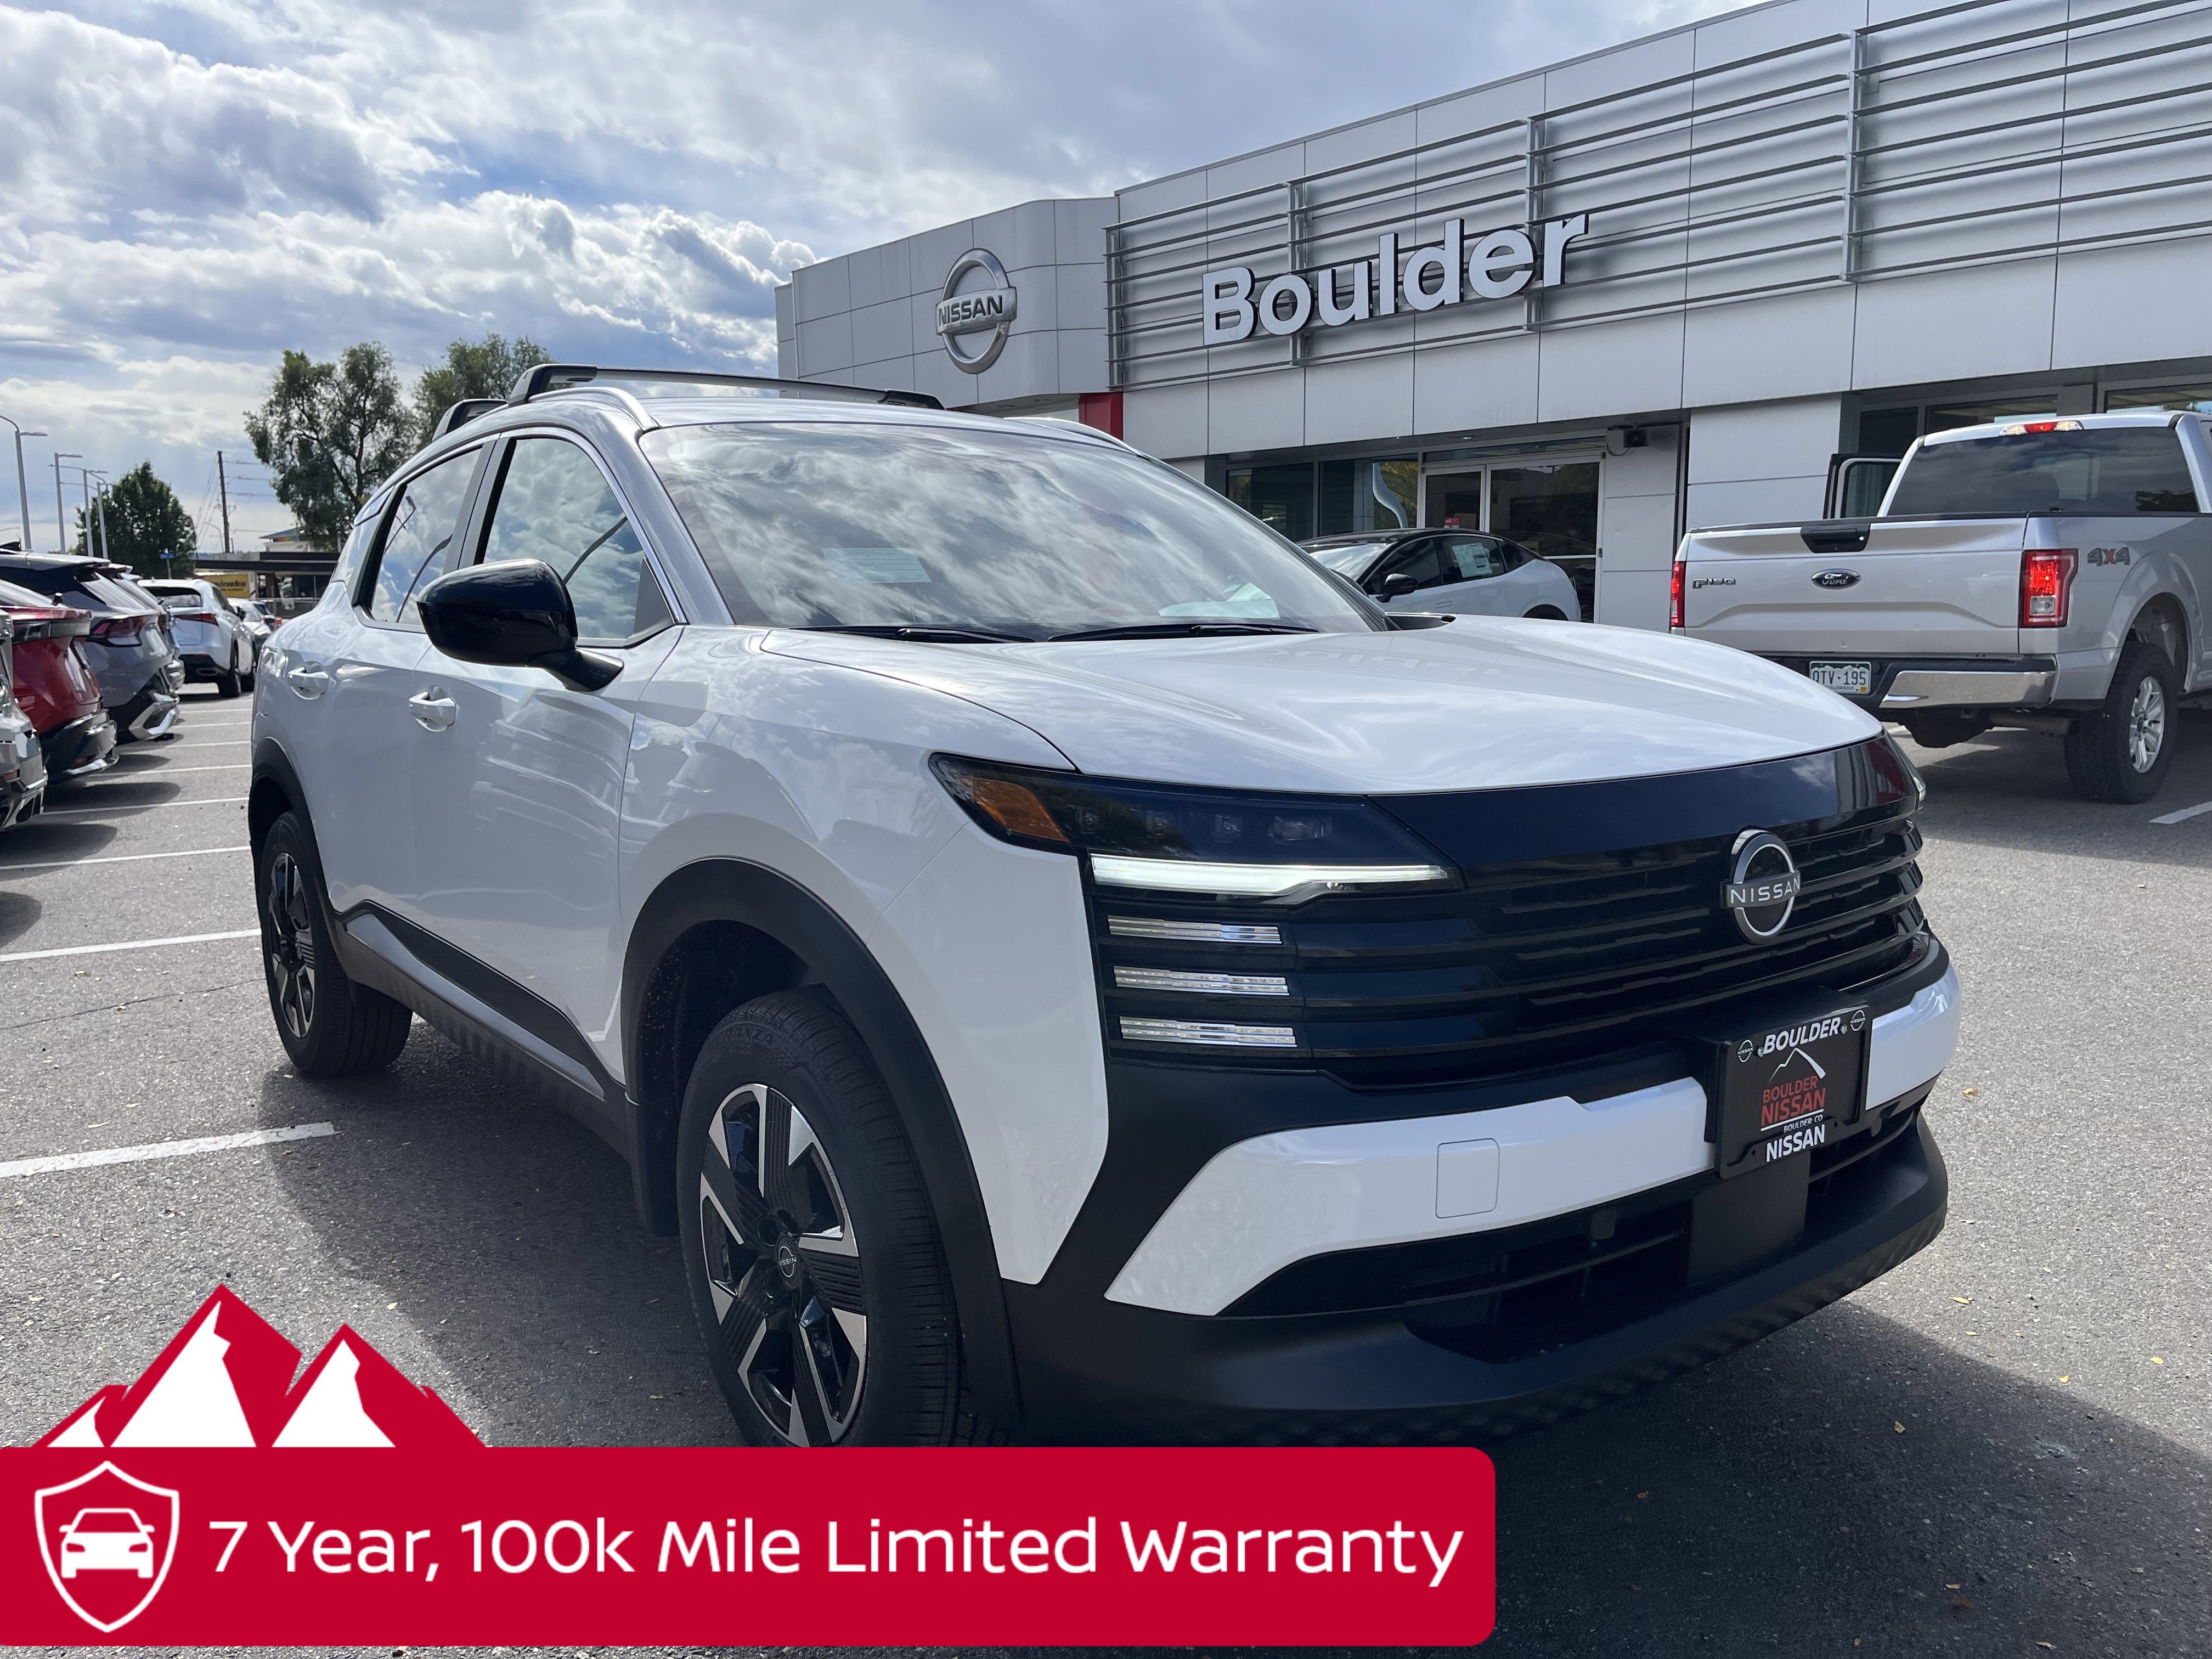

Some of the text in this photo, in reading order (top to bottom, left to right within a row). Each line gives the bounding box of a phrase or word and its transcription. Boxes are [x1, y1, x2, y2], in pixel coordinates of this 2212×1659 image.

[1203, 213, 1589, 346] Boulder
[939, 295, 1003, 326] NISSAN
[1821, 573, 1849, 585] Ford
[1730, 875, 1800, 904] NISSAN
[1763, 1017, 1841, 1054] BOULDER
[1763, 1075, 1818, 1103] BOULDER
[1761, 1087, 1826, 1126] NISSAN
[1784, 1114, 1823, 1133] BOULDER CO
[1766, 1124, 1825, 1162] NISSAN
